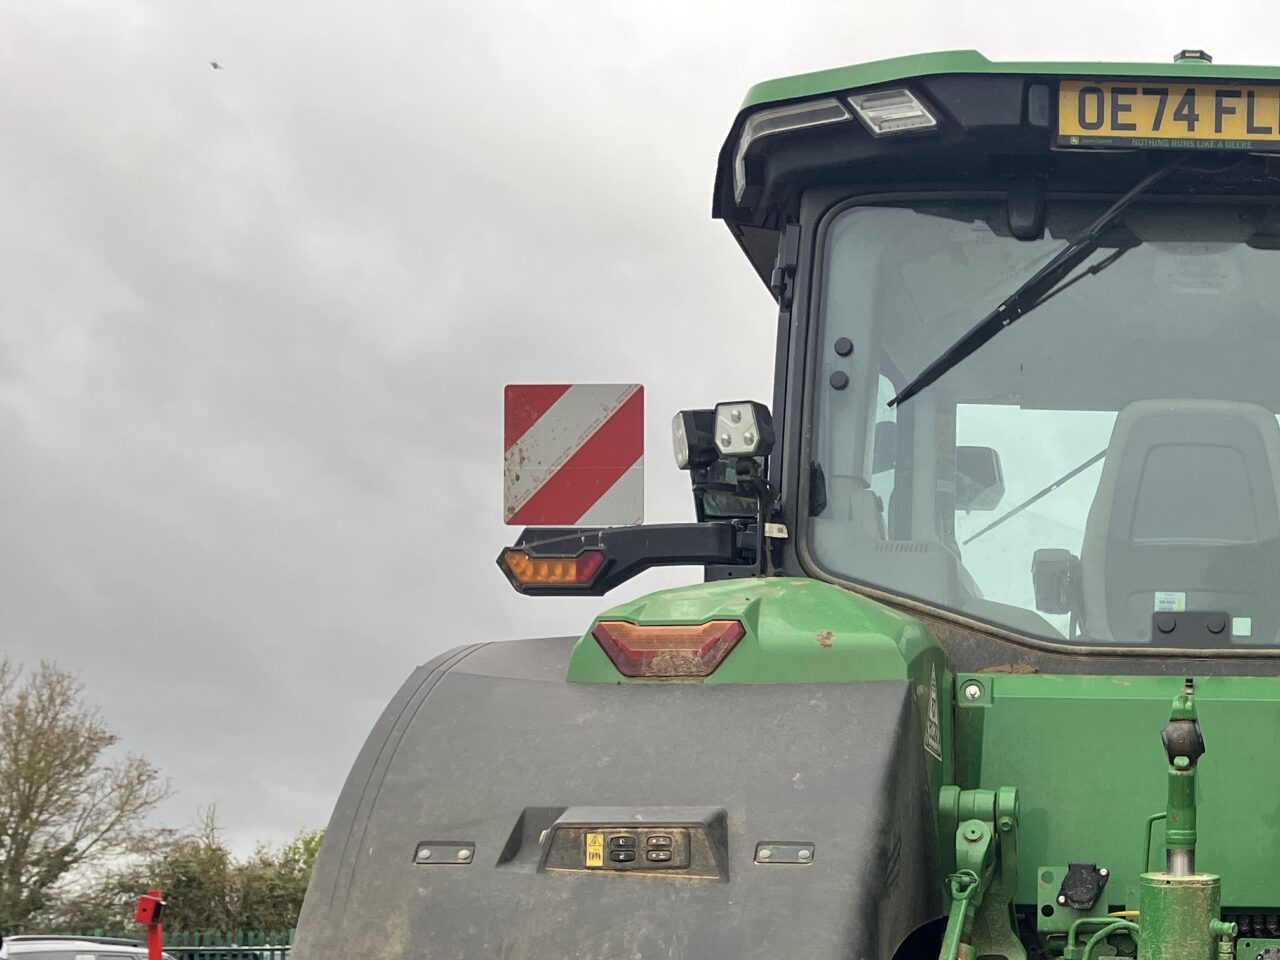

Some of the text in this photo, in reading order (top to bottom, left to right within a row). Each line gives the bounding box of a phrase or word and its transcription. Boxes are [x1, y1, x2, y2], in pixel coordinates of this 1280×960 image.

[1078, 86, 1200, 132] OE74
[1132, 138, 1169, 147] NOTHING
[1172, 139, 1194, 148] RUNS
[1197, 140, 1215, 148] LIKE
[1225, 140, 1253, 149] DEERE
